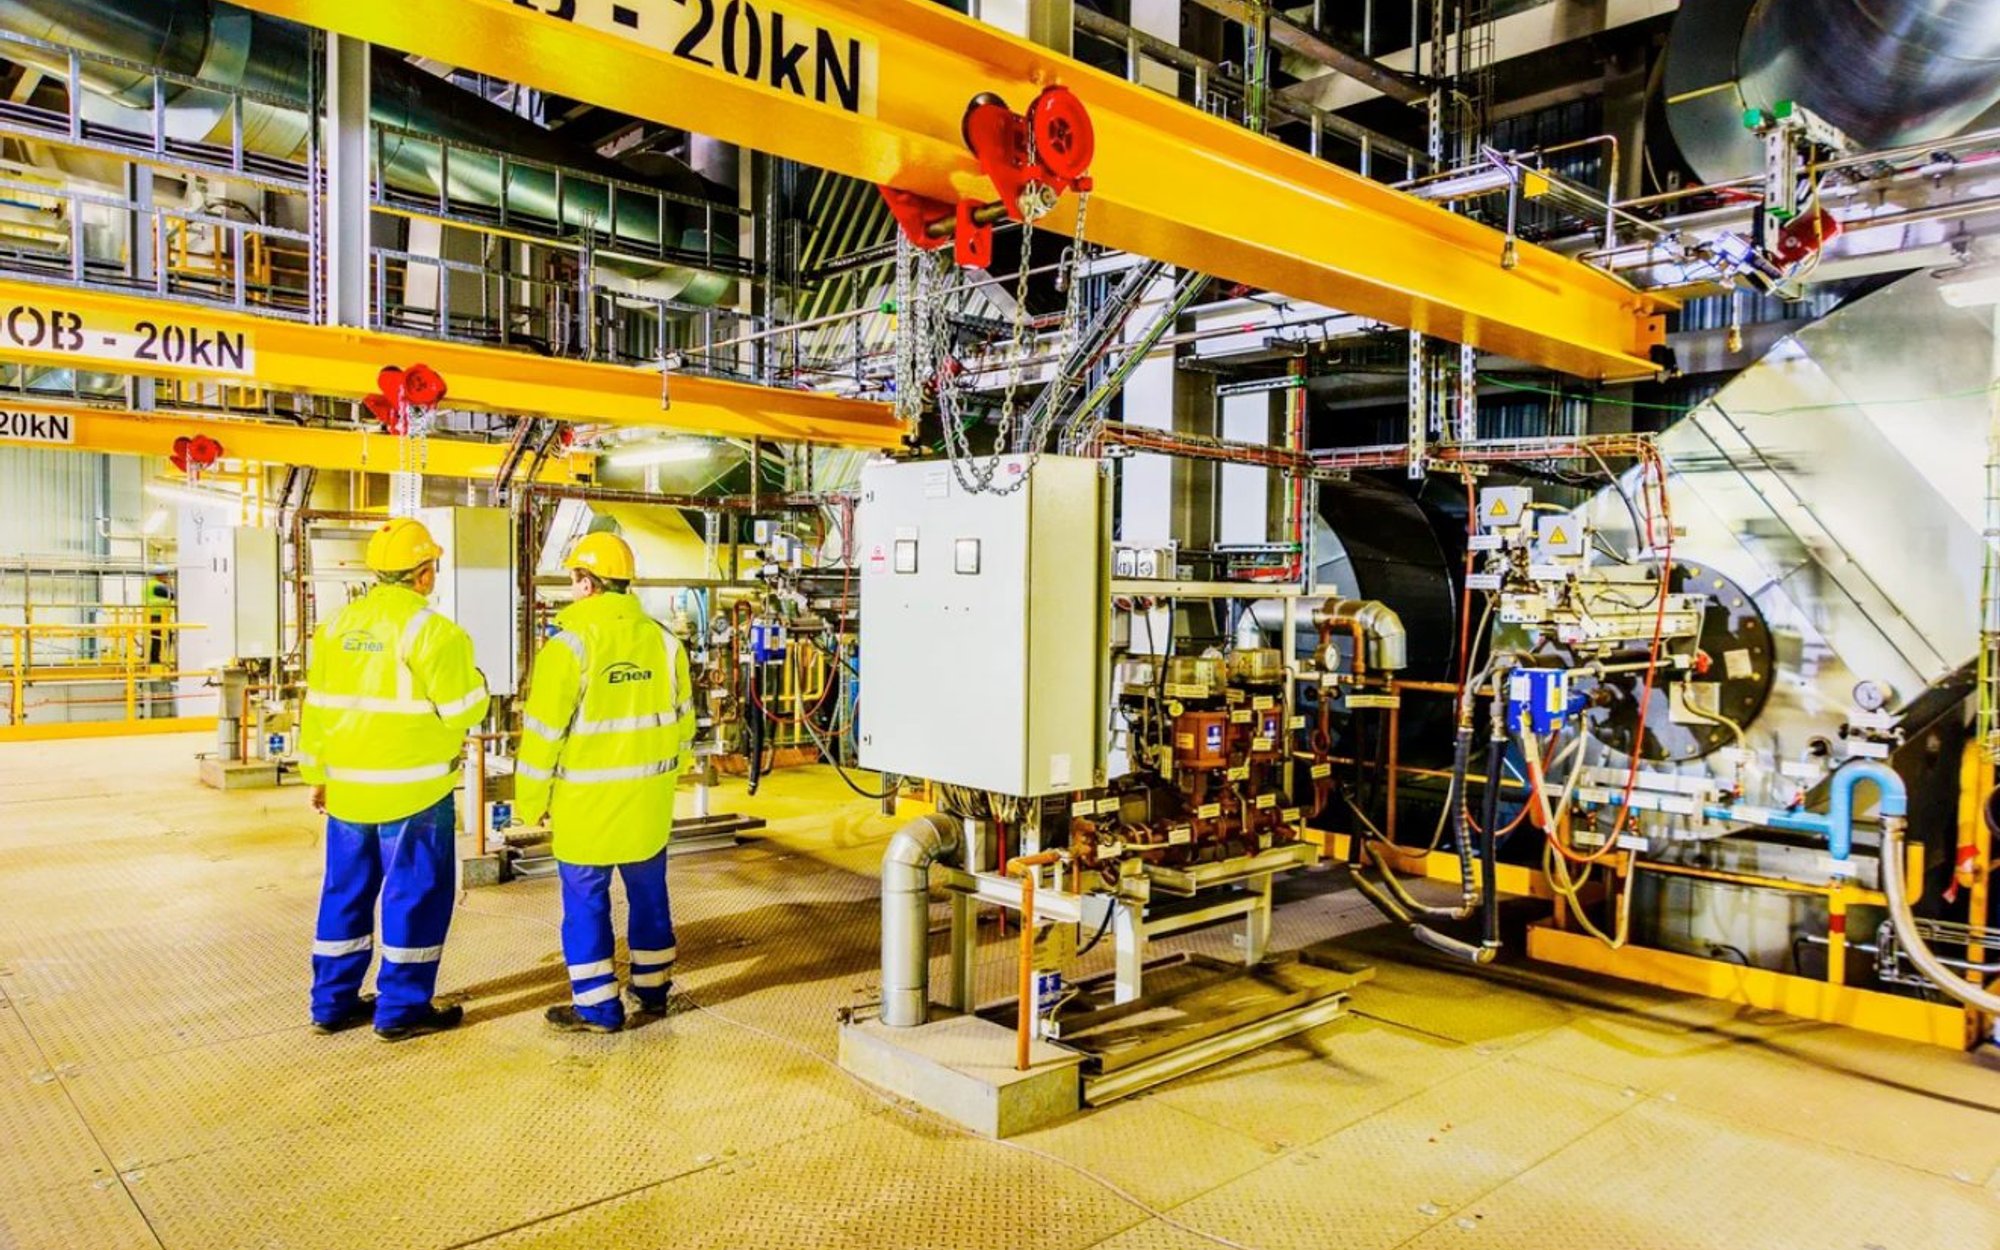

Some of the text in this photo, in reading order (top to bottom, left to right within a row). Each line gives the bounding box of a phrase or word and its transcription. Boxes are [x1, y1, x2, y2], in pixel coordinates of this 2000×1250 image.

[672, 0, 860, 113] 20kN
[0, 305, 84, 351] OB
[134, 321, 245, 369] 20kN
[0, 411, 68, 440] 20kN
[608, 670, 652, 684] Enea
